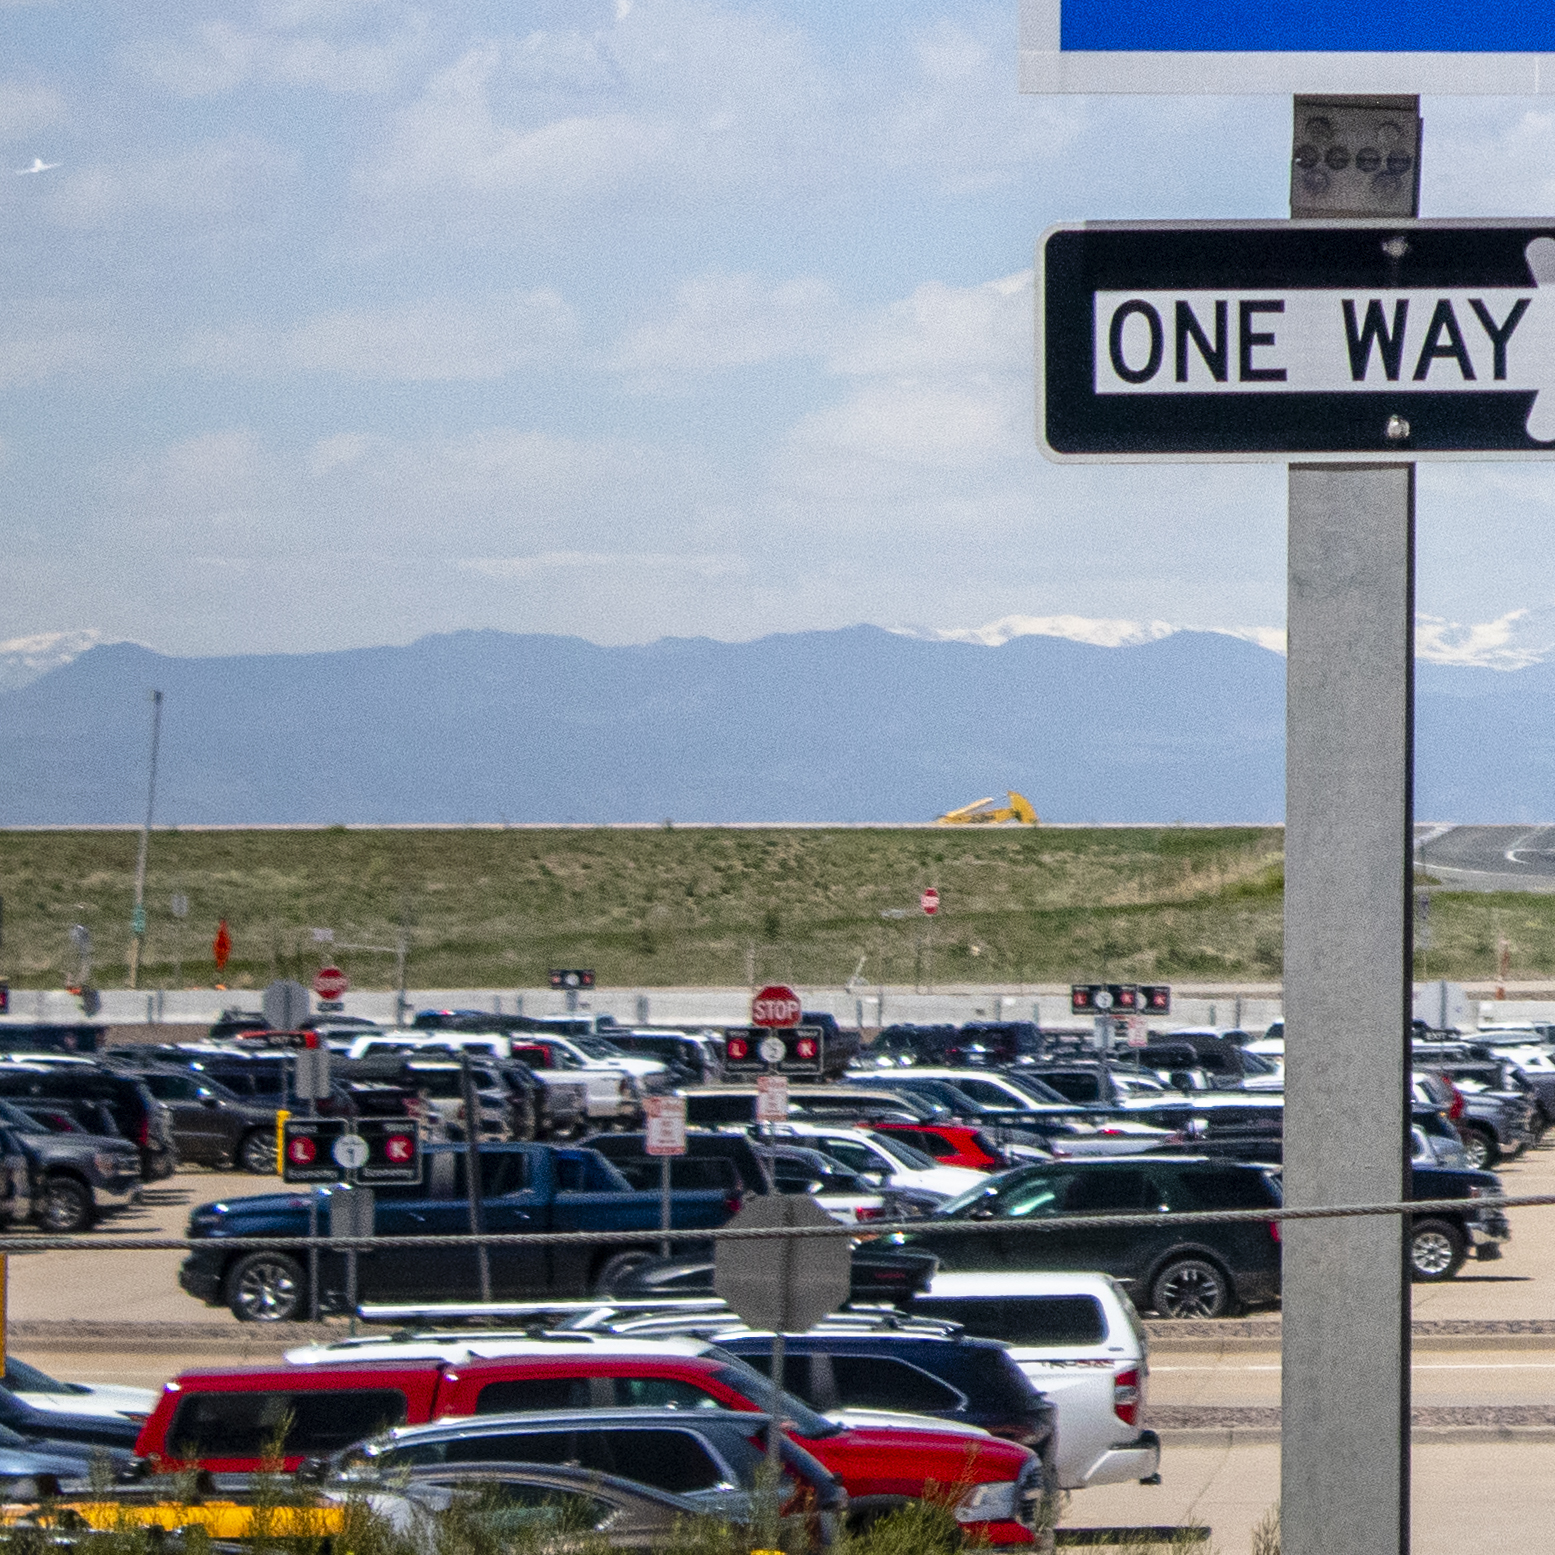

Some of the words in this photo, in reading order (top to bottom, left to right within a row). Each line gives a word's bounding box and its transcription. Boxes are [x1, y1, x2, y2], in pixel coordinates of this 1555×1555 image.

[1110, 301, 1286, 383] ONE
[1343, 300, 1529, 380] WAY
[754, 1000, 799, 1021] STOP
[294, 1142, 311, 1160] L
[390, 1141, 409, 1158] K
